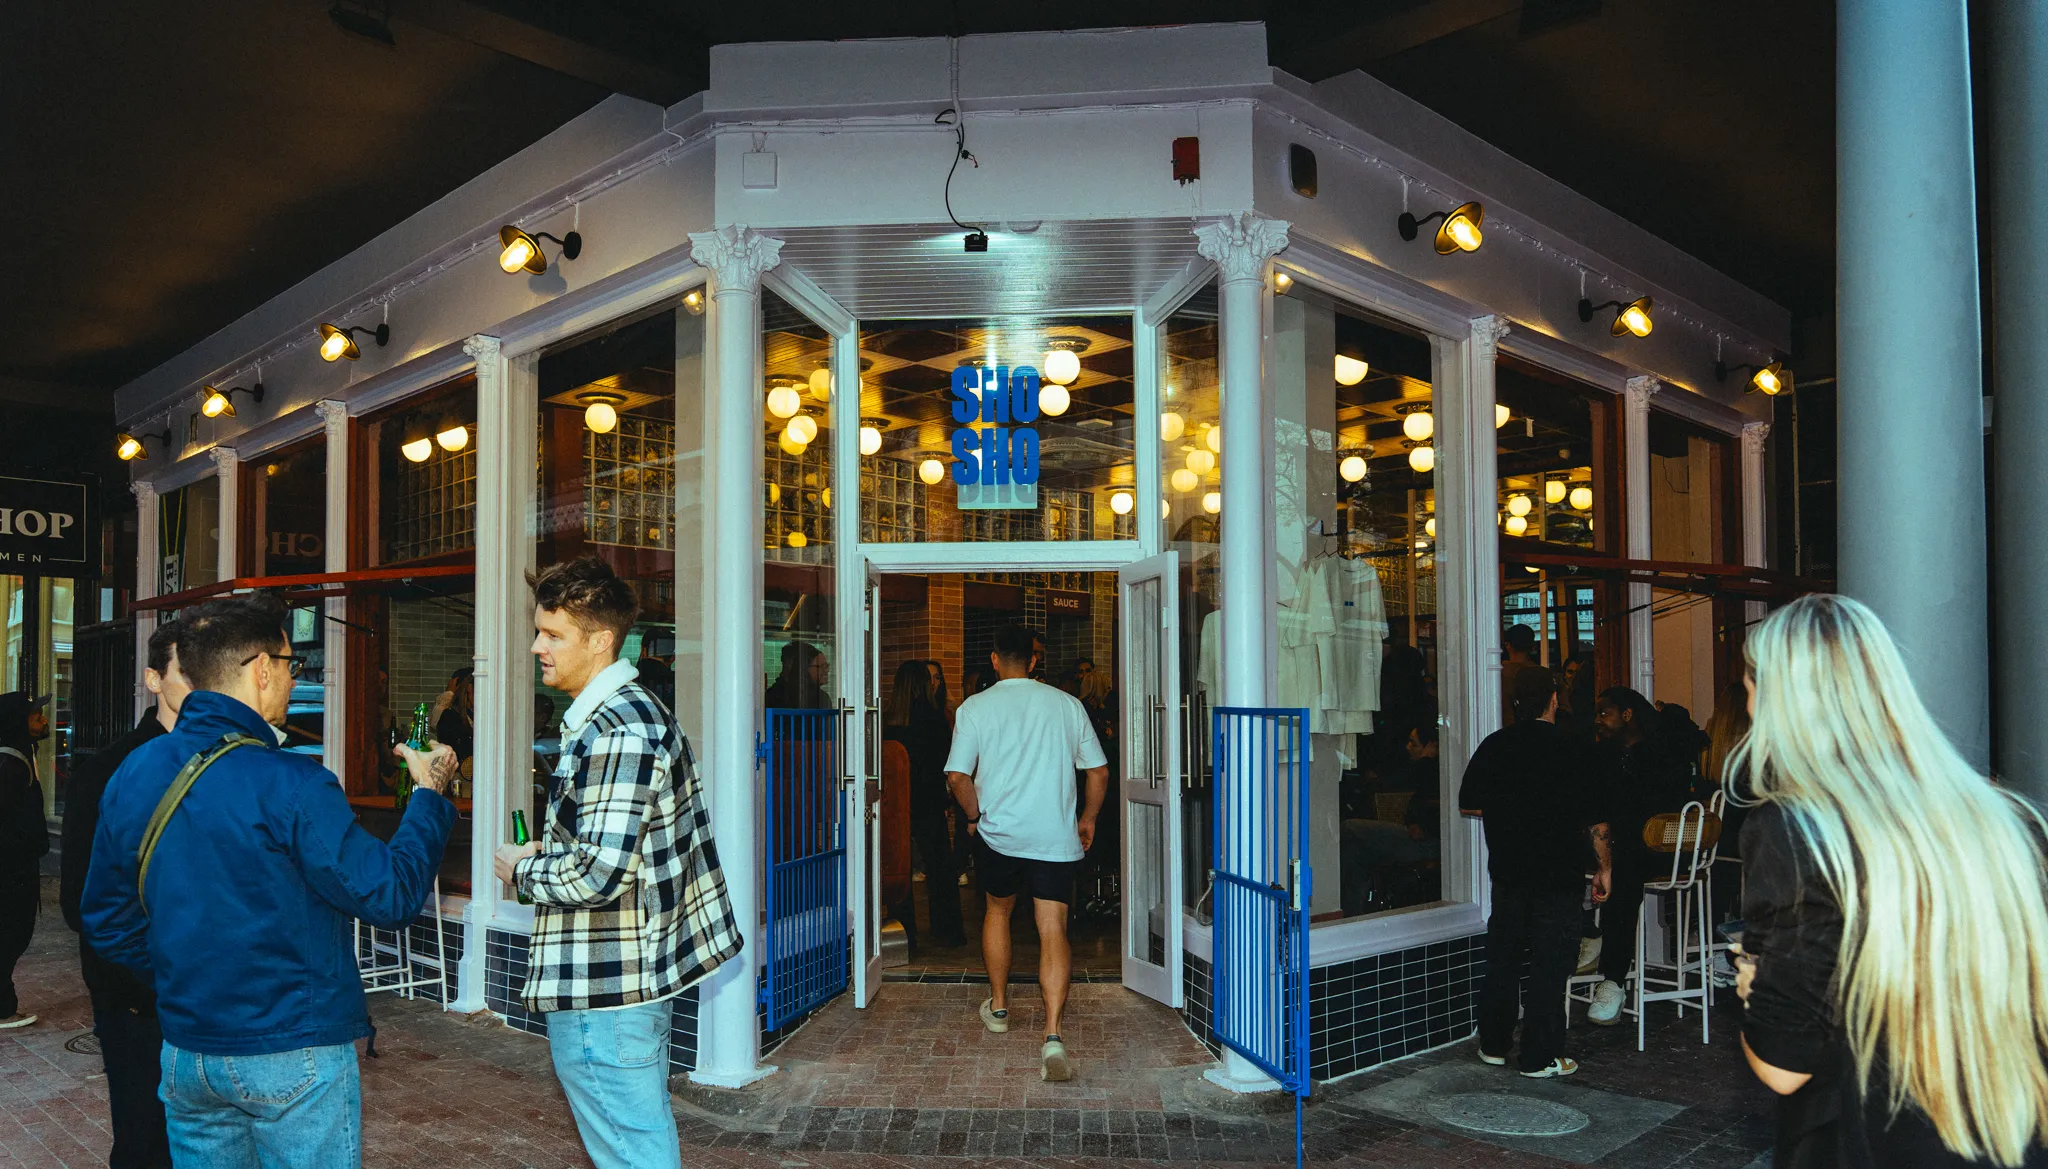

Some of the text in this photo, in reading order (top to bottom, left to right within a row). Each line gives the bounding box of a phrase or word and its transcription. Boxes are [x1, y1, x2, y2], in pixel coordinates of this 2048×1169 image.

[951, 365, 1040, 423] SHO
[951, 427, 1040, 485] SHO
[1053, 597, 1079, 609] SAUCE
